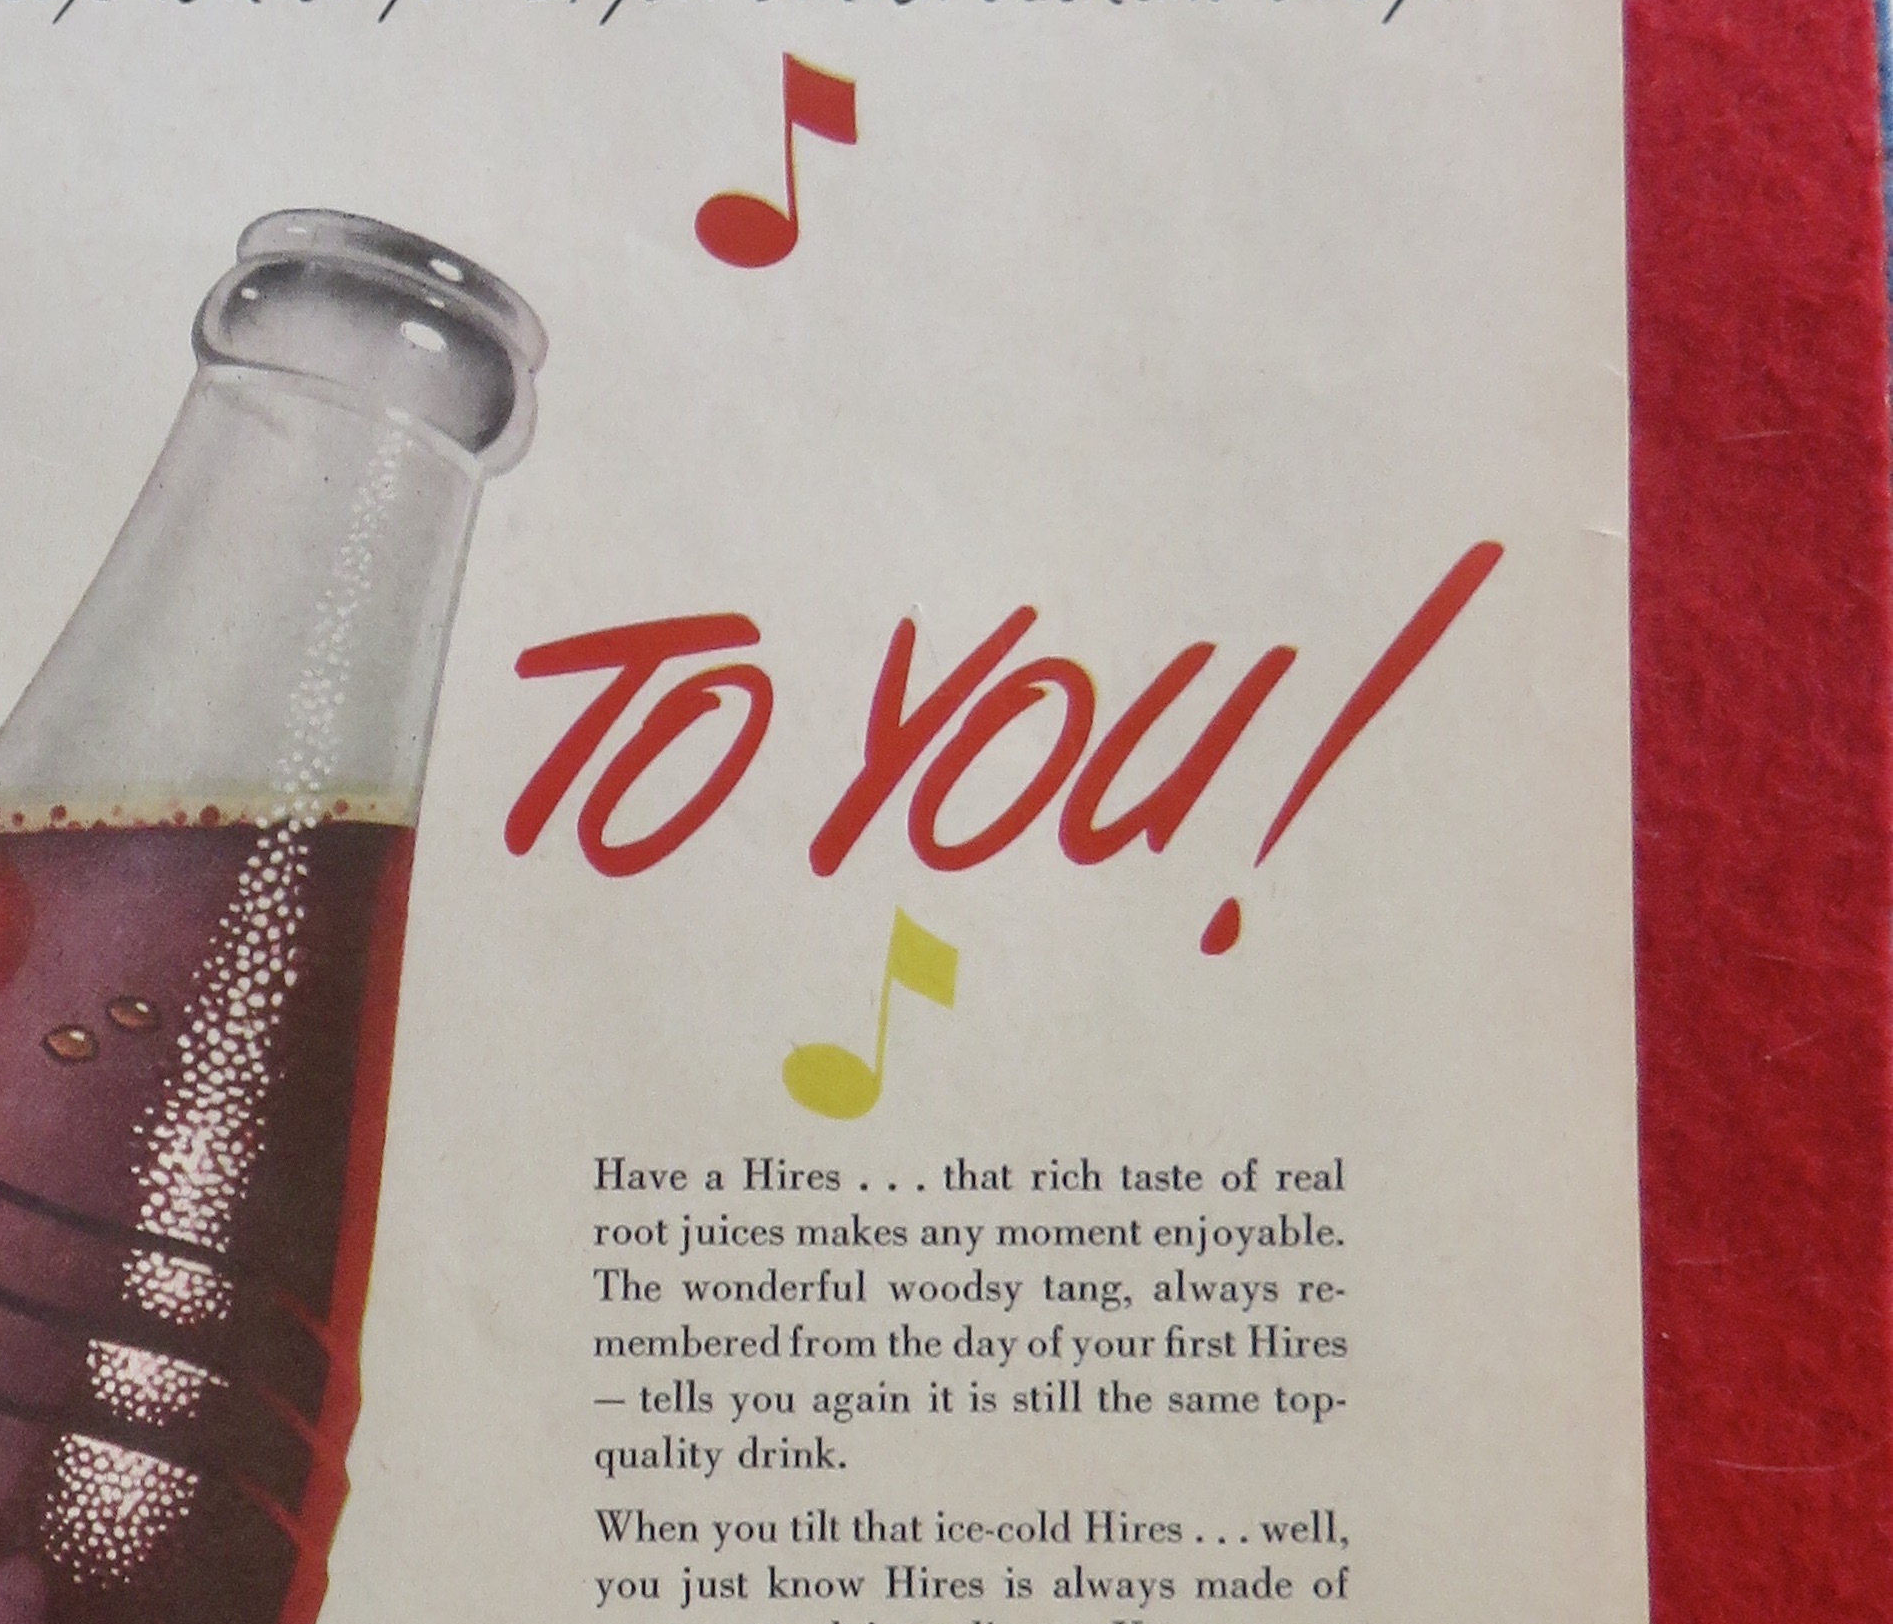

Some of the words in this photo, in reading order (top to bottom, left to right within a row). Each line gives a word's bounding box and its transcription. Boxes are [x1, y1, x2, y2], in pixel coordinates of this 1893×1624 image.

[505, 612, 775, 878] TO
[809, 541, 1505, 955] YOU!
[595, 1157, 689, 1192] Have
[705, 1170, 726, 1193] a
[744, 1157, 842, 1193] Hires
[944, 1157, 1014, 1193] that
[1031, 1157, 1104, 1193] rich
[1122, 1165, 1204, 1194] taste
[1221, 1157, 1260, 1194] of
[1276, 1158, 1346, 1193] real
[594, 1220, 670, 1248] root
[679, 1214, 786, 1258] juices
[797, 1213, 909, 1248] makes
[921, 1226, 986, 1258] any
[997, 1220, 1143, 1248] moment
[1154, 1212, 1345, 1259] enjoyable.
[593, 1268, 663, 1304] The
[682, 1268, 868, 1304] wonderful
[888, 1268, 1025, 1314] woodsy
[1044, 1275, 1134, 1314] tang,
[1154, 1269, 1280, 1314] always
[1299, 1282, 1346, 1304] re-
[594, 1324, 782, 1360] membered
[789, 1324, 878, 1359] from
[889, 1323, 943, 1360] the
[953, 1324, 1019, 1369] day
[1028, 1324, 1065, 1360] of
[1072, 1337, 1157, 1369] your
[1165, 1324, 1238, 1360] first
[1249, 1324, 1349, 1359] Hires
[640, 1379, 715, 1415] tells
[731, 1393, 796, 1425] you
[813, 1381, 912, 1425] again
[929, 1381, 955, 1415] it
[970, 1381, 998, 1415] is
[1013, 1380, 1083, 1415] still
[1098, 1380, 1153, 1415] the
[1169, 1393, 1261, 1415] same
[1275, 1387, 1348, 1425] top-
[595, 1435, 724, 1481] quality
[738, 1435, 848, 1471] drink.
[595, 1509, 700, 1544] When
[713, 1522, 779, 1554] you
[791, 1509, 842, 1544] tilt
[853, 1509, 924, 1545] that
[936, 1510, 1072, 1545] ice-cold
[1086, 1510, 1184, 1545] Hires
[1261, 1510, 1350, 1549] well,
[596, 1578, 661, 1610] you
[681, 1567, 750, 1611] just
[768, 1565, 867, 1600] know
[886, 1565, 986, 1601] Hires
[1006, 1567, 1034, 1601] is
[1054, 1565, 1177, 1611] always
[1197, 1566, 1294, 1601] made
[1313, 1566, 1351, 1600] of
